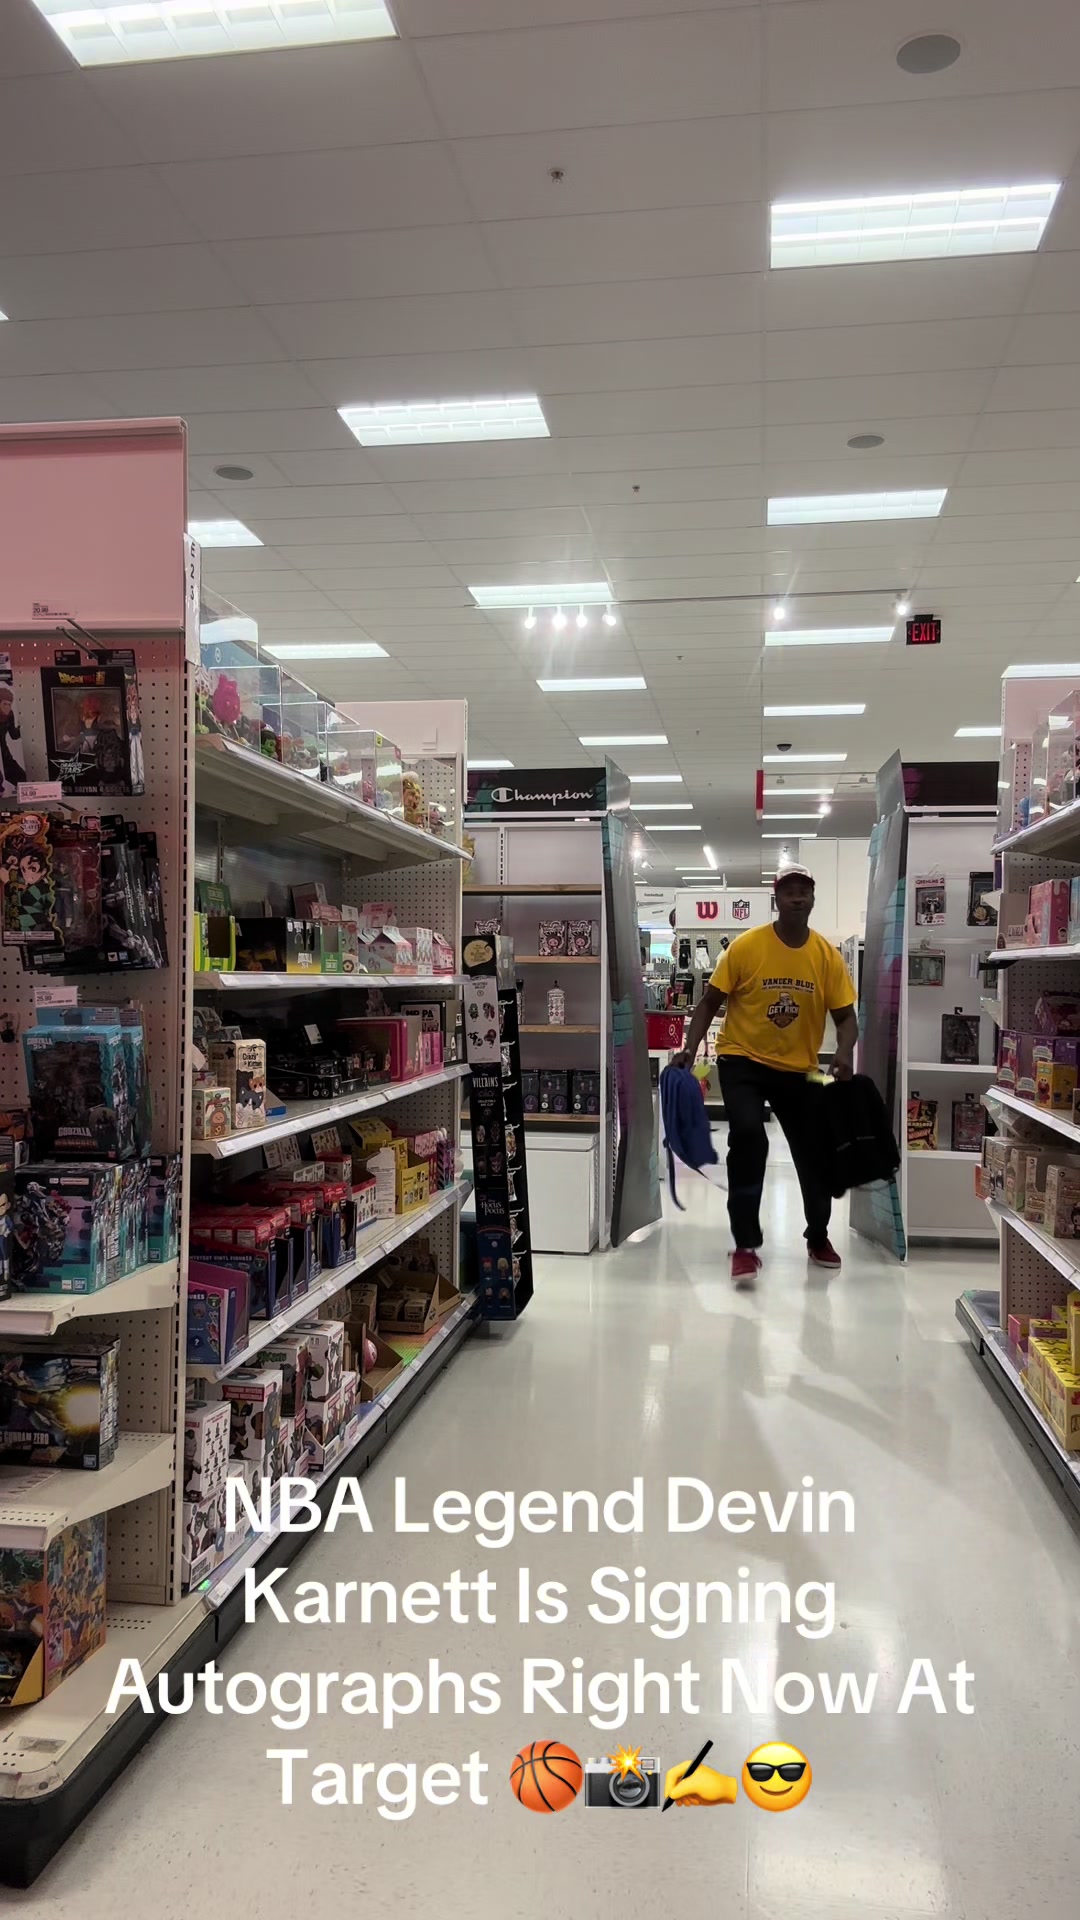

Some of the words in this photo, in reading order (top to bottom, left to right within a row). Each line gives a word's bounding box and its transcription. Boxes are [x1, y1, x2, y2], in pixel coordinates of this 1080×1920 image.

[911, 622, 937, 642] EXIT
[59, 766, 82, 775] STARS
[491, 786, 594, 806] Champion
[734, 908, 749, 918] NFL
[795, 979, 815, 990] BLUE
[769, 1005, 783, 1015] GET
[26, 1037, 53, 1046] GODZILLA
[472, 1076, 499, 1088] VILLAINS
[58, 1126, 92, 1138] GODZILLA
[4, 1431, 32, 1442] GUNDAM
[33, 1432, 50, 1445] ZERO
